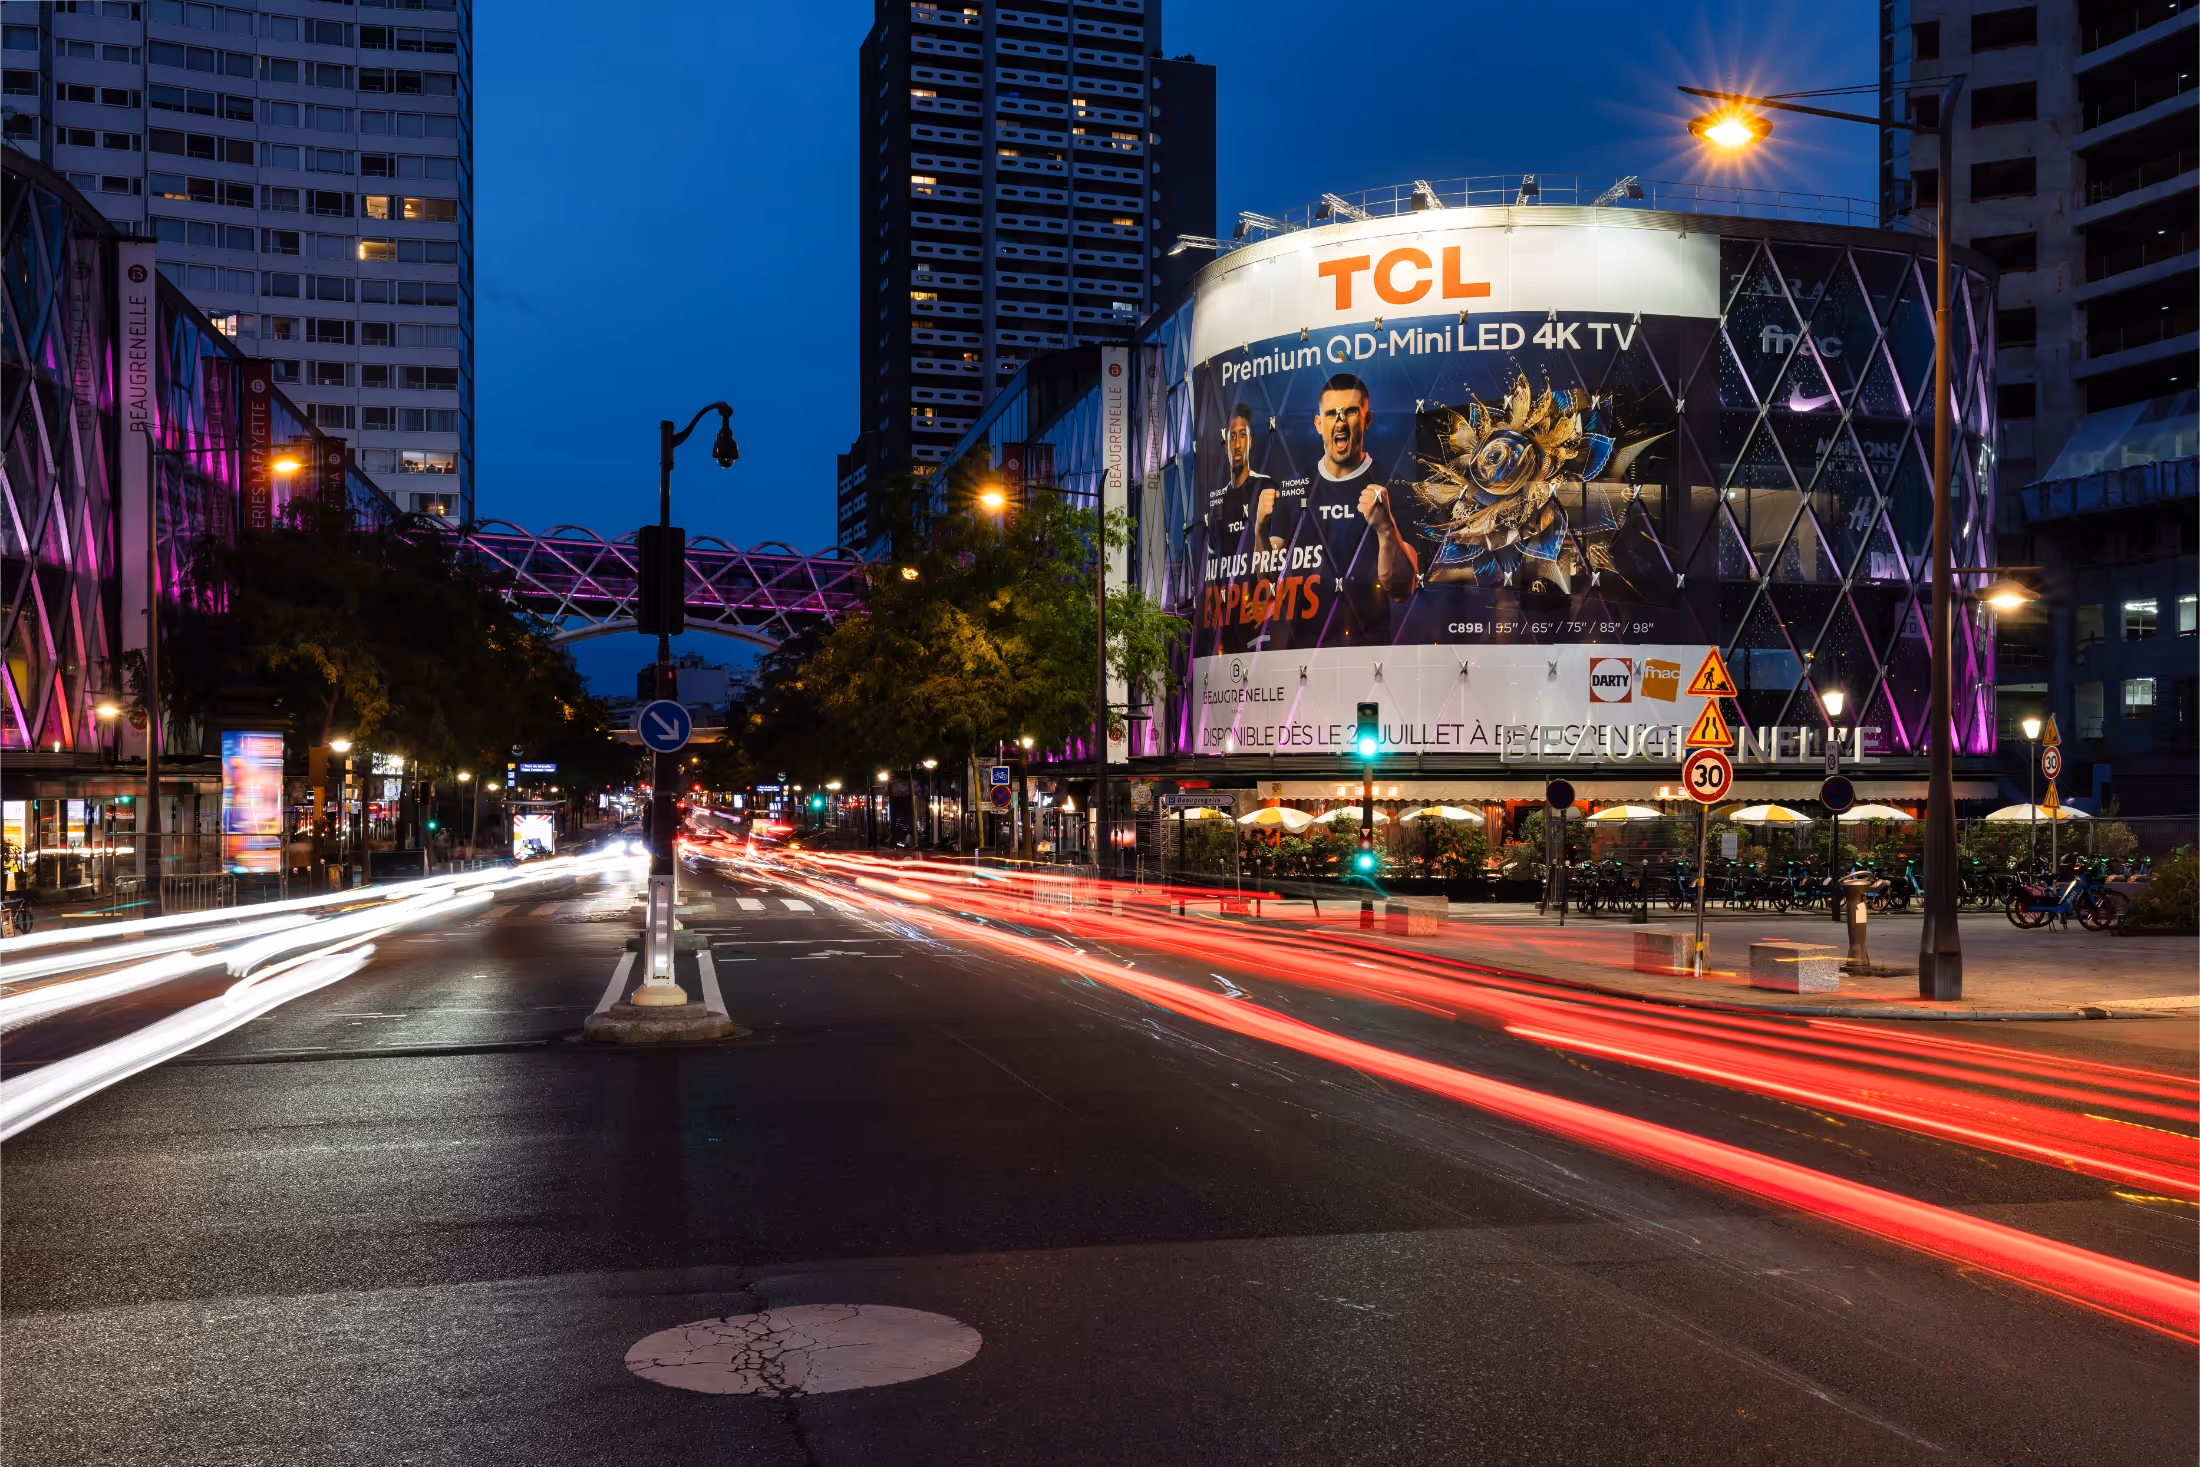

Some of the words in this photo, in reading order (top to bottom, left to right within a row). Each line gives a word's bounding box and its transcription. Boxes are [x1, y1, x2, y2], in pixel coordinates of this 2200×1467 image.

[1319, 246, 1491, 311] TCL
[129, 295, 147, 432] BEAUGRENELLE
[1222, 345, 1321, 387] Premium
[1533, 322, 1582, 350] 4K
[1588, 322, 1637, 351] TV
[1109, 386, 1122, 489] BEAUGRENELLE
[1281, 477, 1310, 488] THOMAS
[1281, 487, 1306, 498] RAMOS
[1319, 504, 1355, 520] TCL
[1227, 520, 1246, 533] TCL
[1205, 557, 1218, 582] AU
[1219, 553, 1248, 578] PLUS
[1251, 544, 1288, 575] PRÈS
[1291, 545, 1324, 571] DES
[1203, 573, 1322, 629] EXPLOITS
[1448, 622, 1484, 634] C89B
[1591, 674, 1630, 687] DARTY
[1644, 665, 1681, 680] fnac
[1203, 686, 1285, 705] BEAUGRENELLE
[1203, 726, 1275, 748] DISPONIBLE
[1278, 720, 1313, 746] DÈS
[1318, 724, 1342, 745] LE
[1379, 723, 1465, 745] JUILLET
[1470, 718, 1489, 745] À
[2045, 755, 2058, 770] 30
[1693, 764, 1723, 788] 30
